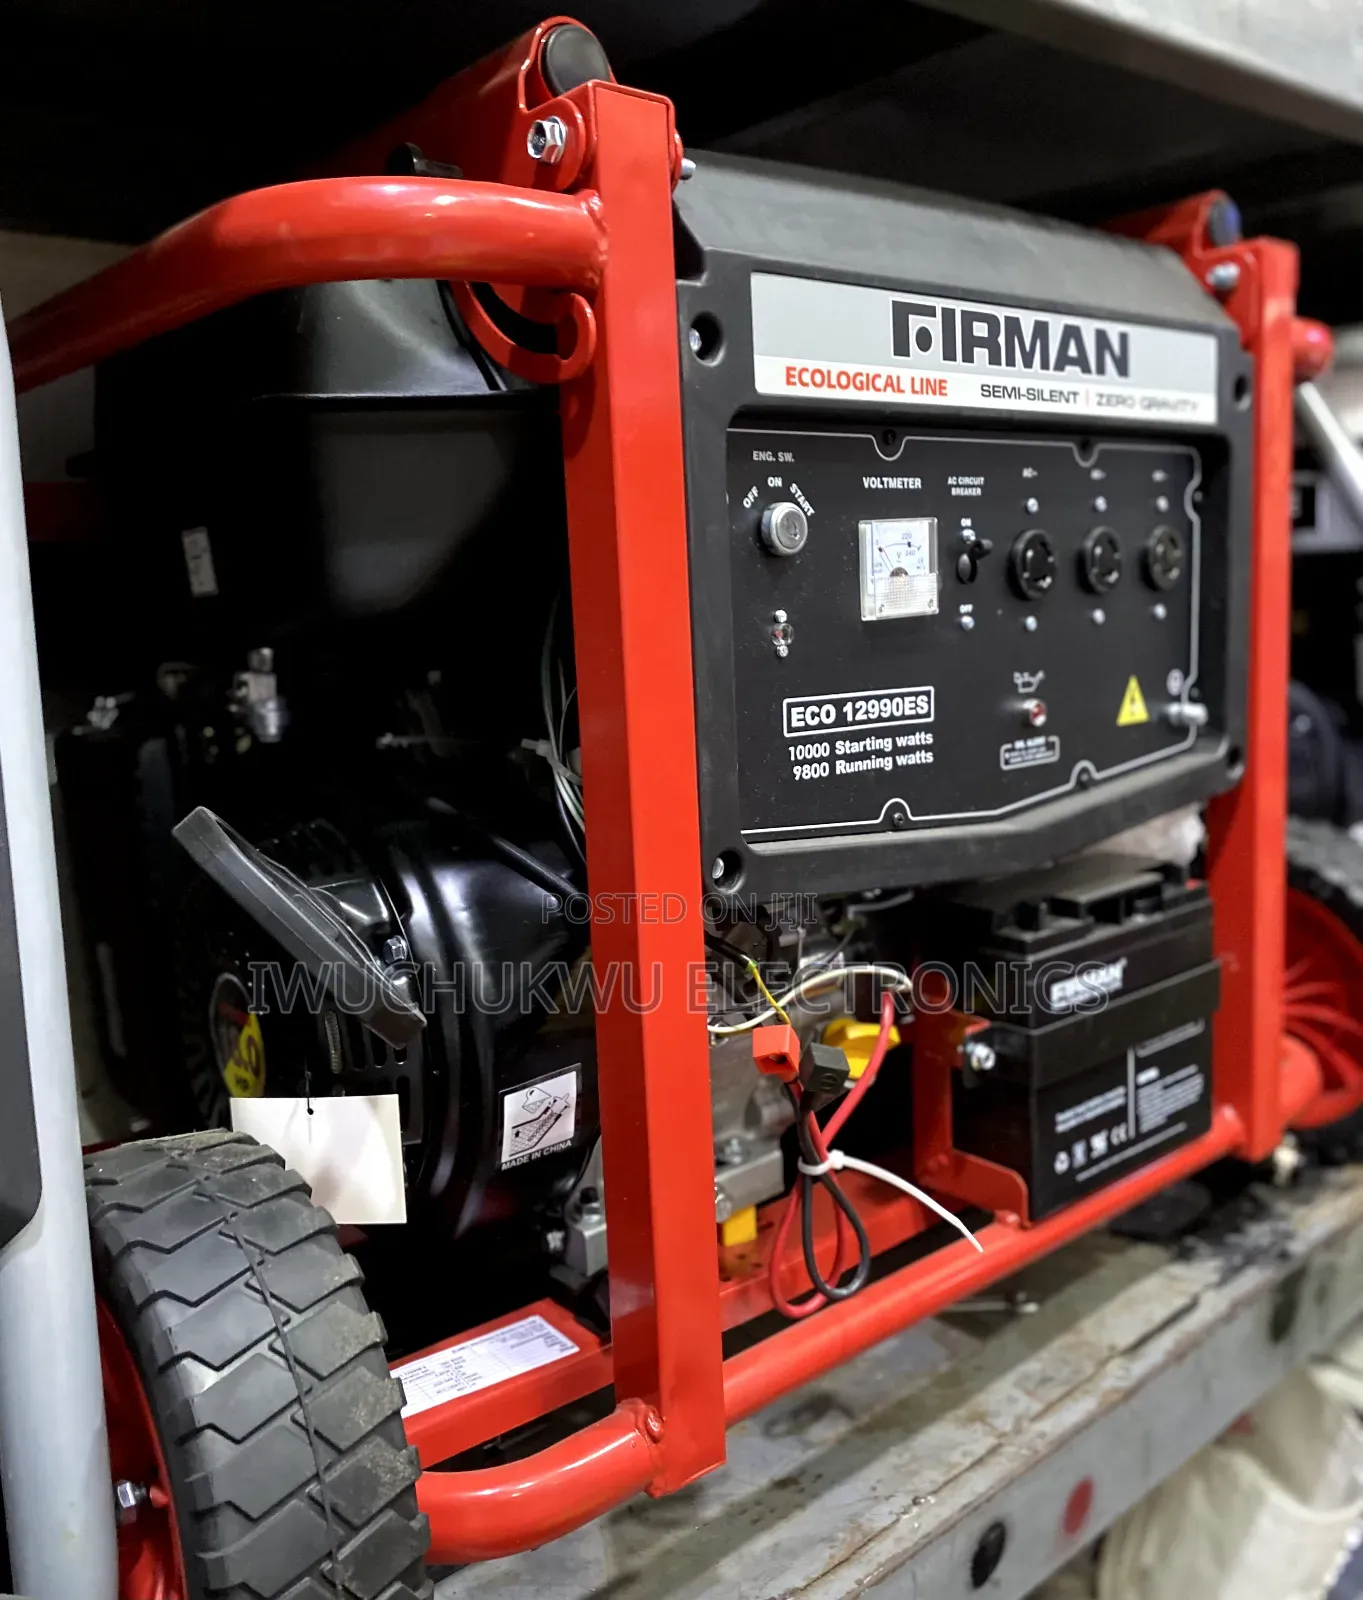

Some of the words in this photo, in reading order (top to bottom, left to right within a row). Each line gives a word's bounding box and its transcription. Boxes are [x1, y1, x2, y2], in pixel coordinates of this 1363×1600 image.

[891, 299, 1130, 378] FIRMAN
[785, 366, 906, 393] ECOLOGICAL
[910, 376, 949, 397] LINE
[980, 384, 1080, 405] SEMI-SILENT
[1095, 391, 1137, 408] ZERO
[752, 450, 776, 462] ENG.
[777, 451, 795, 463] SW.
[767, 476, 783, 488] ON
[862, 476, 922, 489] VOLTMETER
[947, 476, 957, 485] AC
[958, 476, 985, 485] CIRCUIT
[743, 485, 759, 509] OFF
[789, 482, 815, 516] START
[951, 487, 982, 496] BREAKER
[960, 518, 972, 527] ON
[960, 604, 973, 613] OFF
[790, 703, 837, 728] ECO
[843, 694, 930, 722] 12990ES
[788, 742, 831, 761] 10000
[834, 736, 893, 756] Starting
[895, 731, 934, 748] watts
[792, 762, 830, 781] 9800
[834, 755, 893, 775] Running
[895, 749, 934, 767] watts
[501, 1154, 530, 1171] MADE
[531, 1150, 542, 1160] IN
[543, 1140, 572, 1156] CHINA
